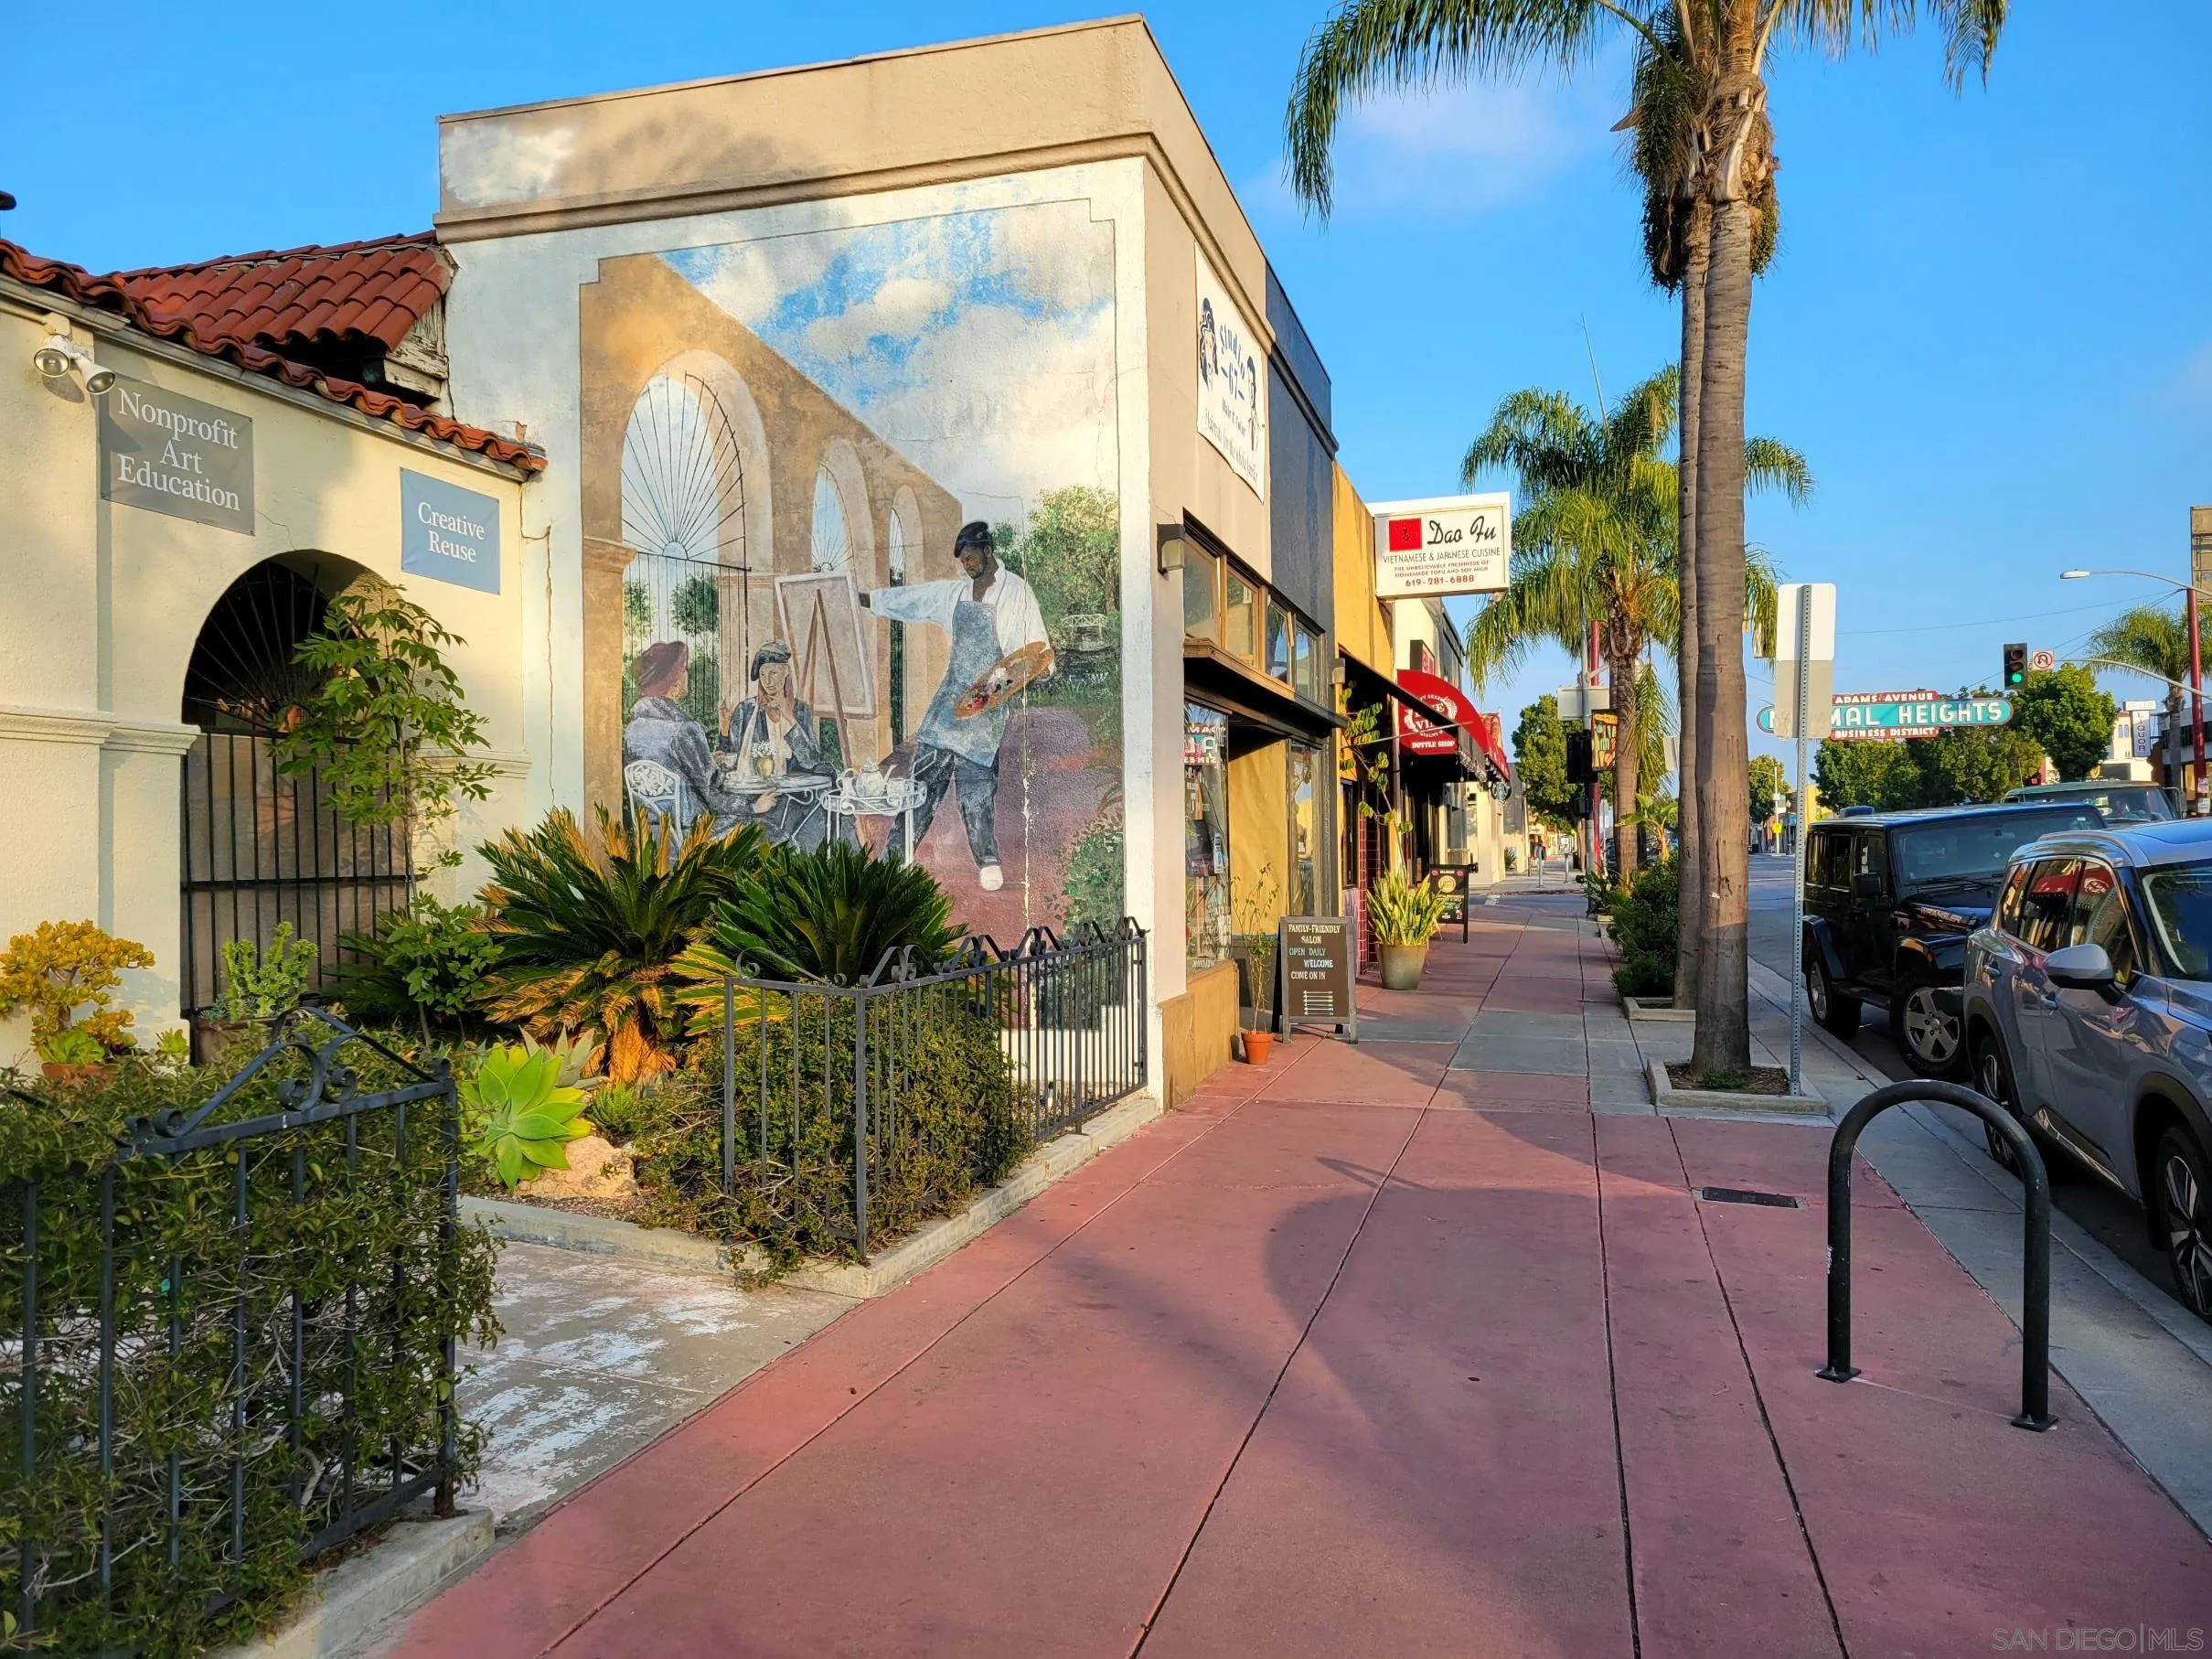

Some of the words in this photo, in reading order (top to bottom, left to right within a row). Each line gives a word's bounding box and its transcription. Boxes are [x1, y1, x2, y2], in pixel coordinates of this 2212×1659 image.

[1220, 325, 1245, 380] Studio
[1228, 362, 1237, 400] 67
[118, 388, 239, 449] Nonprofit
[159, 440, 203, 475] Art
[116, 453, 241, 512] Education
[418, 501, 486, 541] Creative
[1427, 519, 1463, 545] Dao
[1469, 515, 1497, 543] Fu
[427, 530, 476, 563] Reuse
[1383, 552, 1427, 564] VIETNAMESE
[1429, 552, 1435, 561] &
[1437, 550, 1469, 561] JAPANESE
[1471, 547, 1501, 558] CUISINE
[1835, 694, 1877, 704] ADAMS
[1884, 692, 1933, 701] AVENUE
[1898, 701, 2002, 725] HEIGHTS
[1835, 728, 1886, 739] BUSINESS
[1889, 727, 1936, 736] DISTRICT
[2136, 712, 2146, 752] LIQUOR
[1920, 906, 1962, 924] WRANGLER
[1288, 924, 1341, 934] FAMILY-FRIENDLY
[1301, 936, 1322, 944] SALON
[1288, 947, 1306, 956] OPEN
[1309, 947, 1326, 957] DAILY
[1290, 971, 1309, 979] COME
[1309, 971, 1318, 979] ON
[1319, 971, 1326, 980] IN
